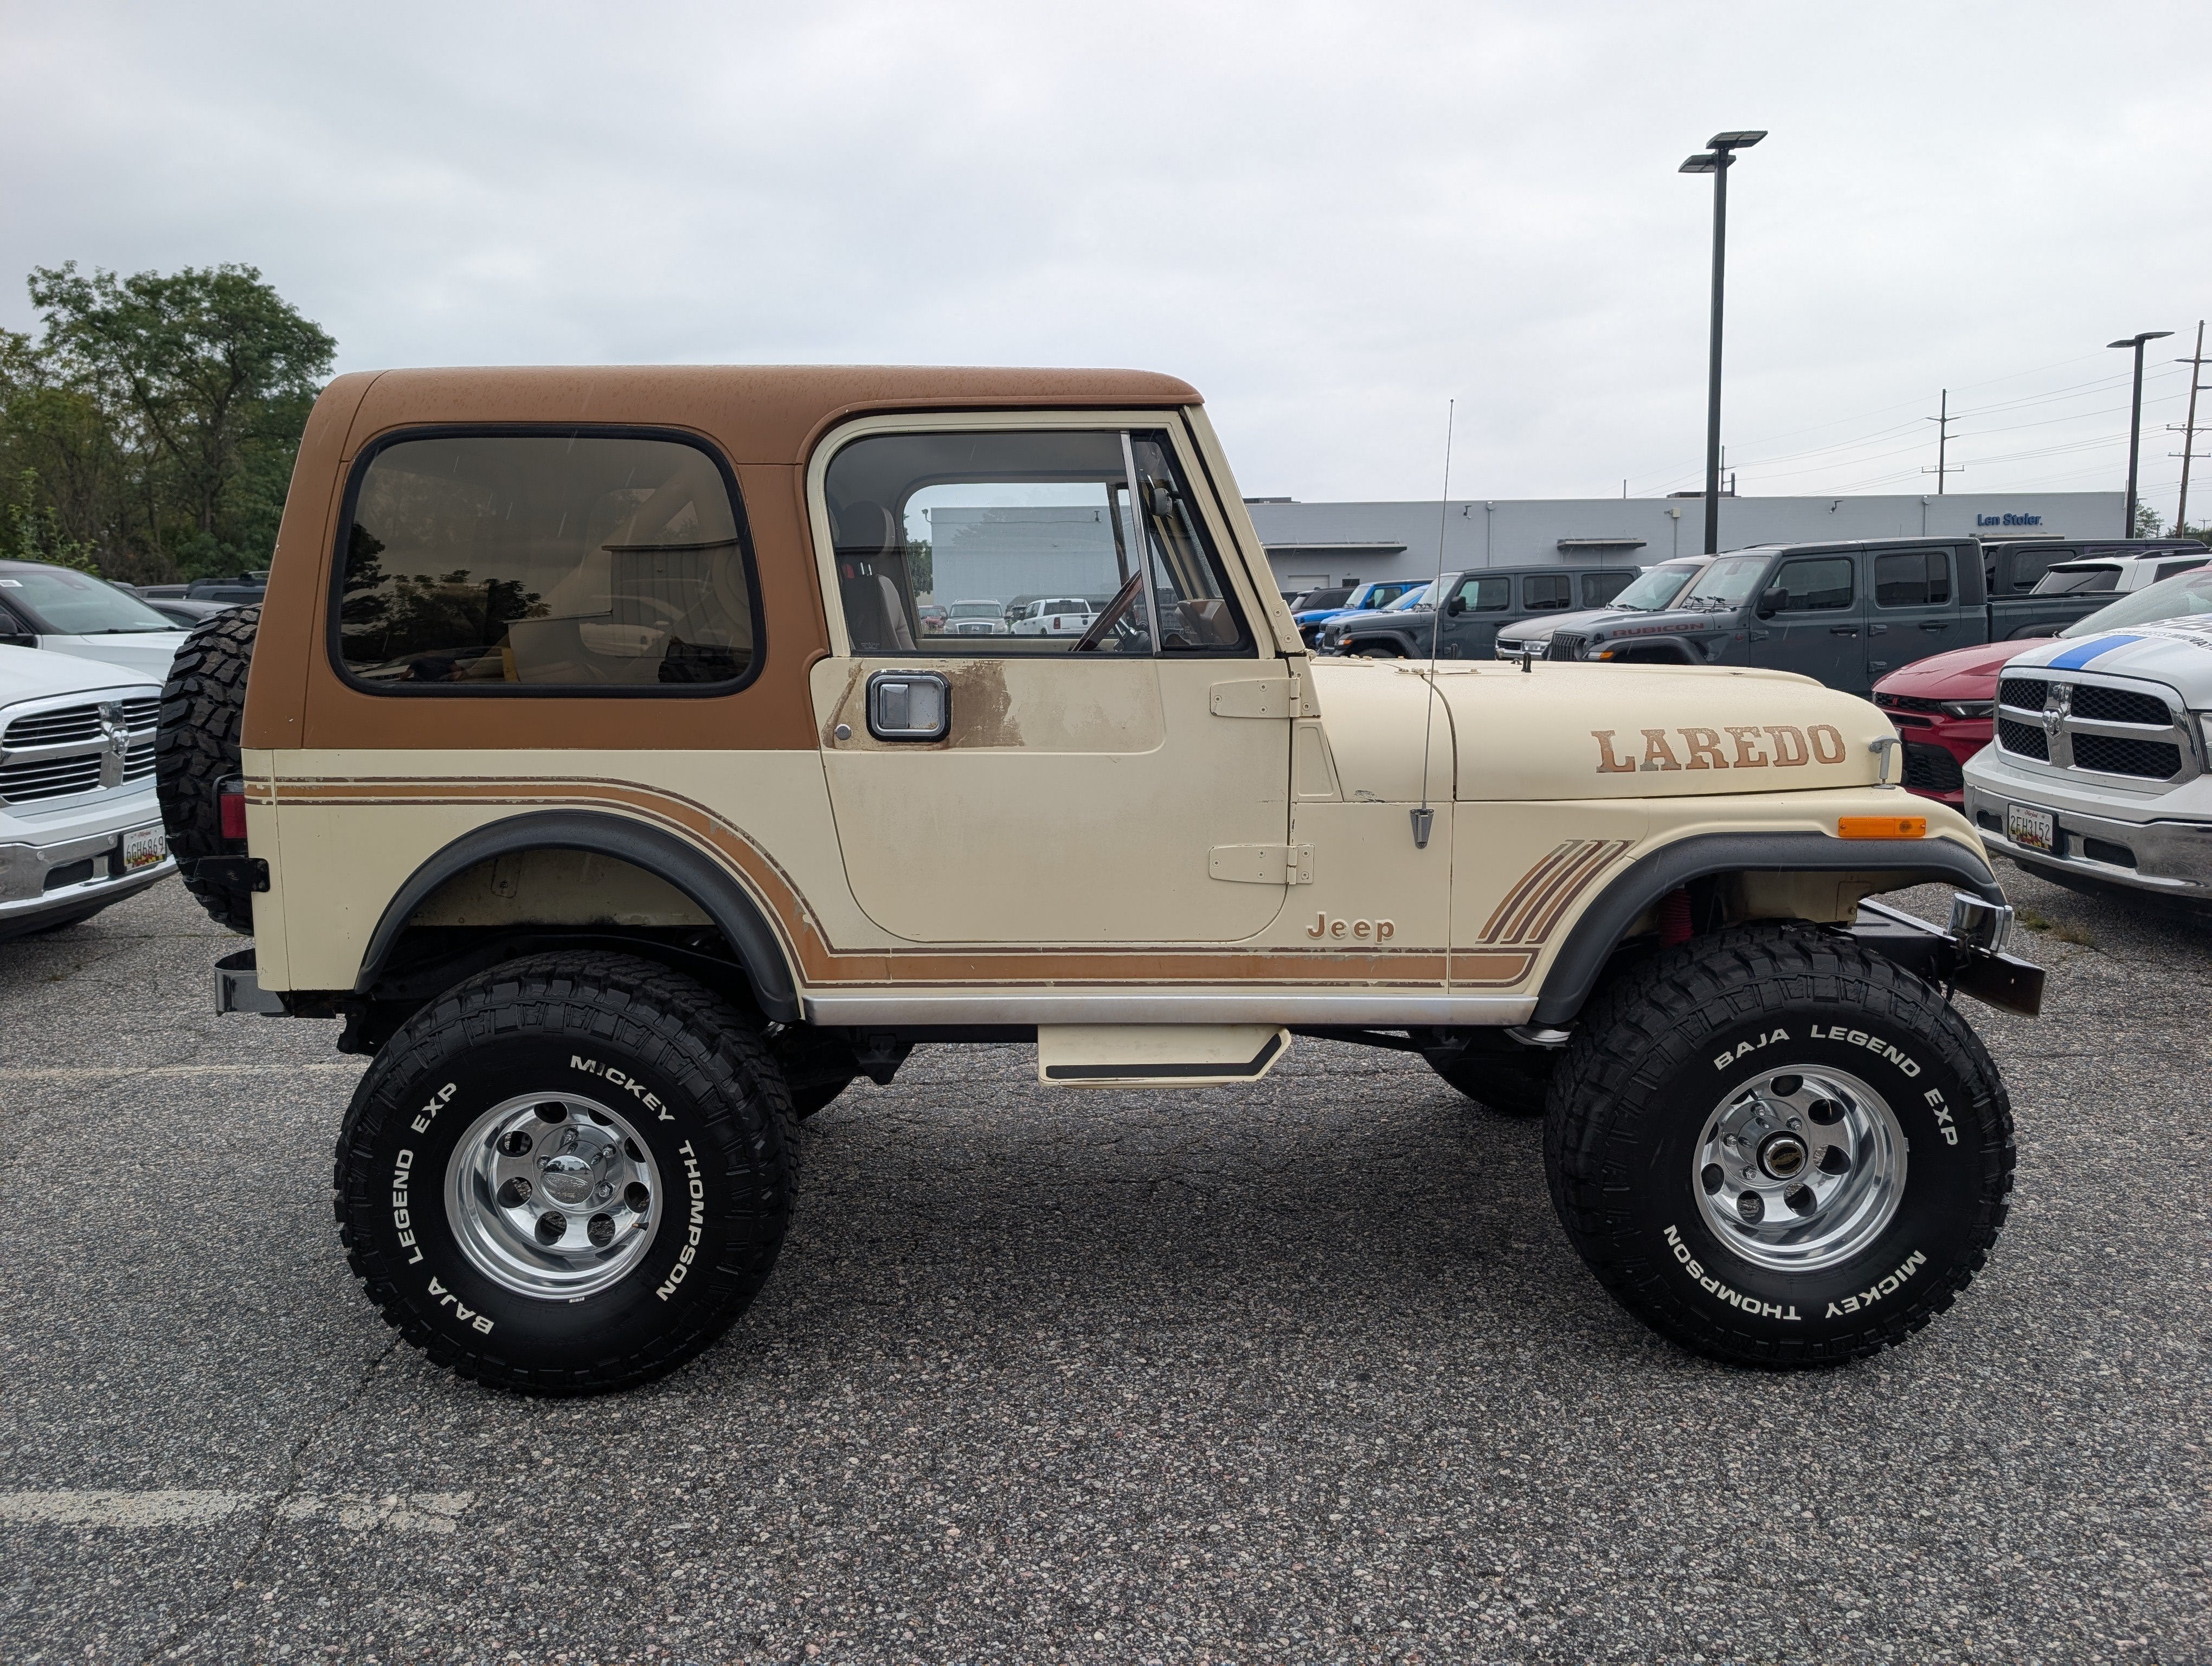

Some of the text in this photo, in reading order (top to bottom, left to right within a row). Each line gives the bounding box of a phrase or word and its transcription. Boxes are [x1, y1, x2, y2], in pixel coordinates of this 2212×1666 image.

[1978, 514, 2000, 526] Len
[1612, 623, 1705, 636] RUBICON
[1591, 725, 1846, 773] LAREDO
[126, 836, 163, 862] 6GH6869
[1306, 912, 1395, 944] Jeep
[1714, 1025, 1958, 1145] BAJA LEGEND EXP
[570, 1055, 704, 1301] MICKEY THOMPSON
[393, 1083, 494, 1335] BAJA LEGEND EXP
[1664, 1225, 1927, 1321] MICKEY THOMPSON
